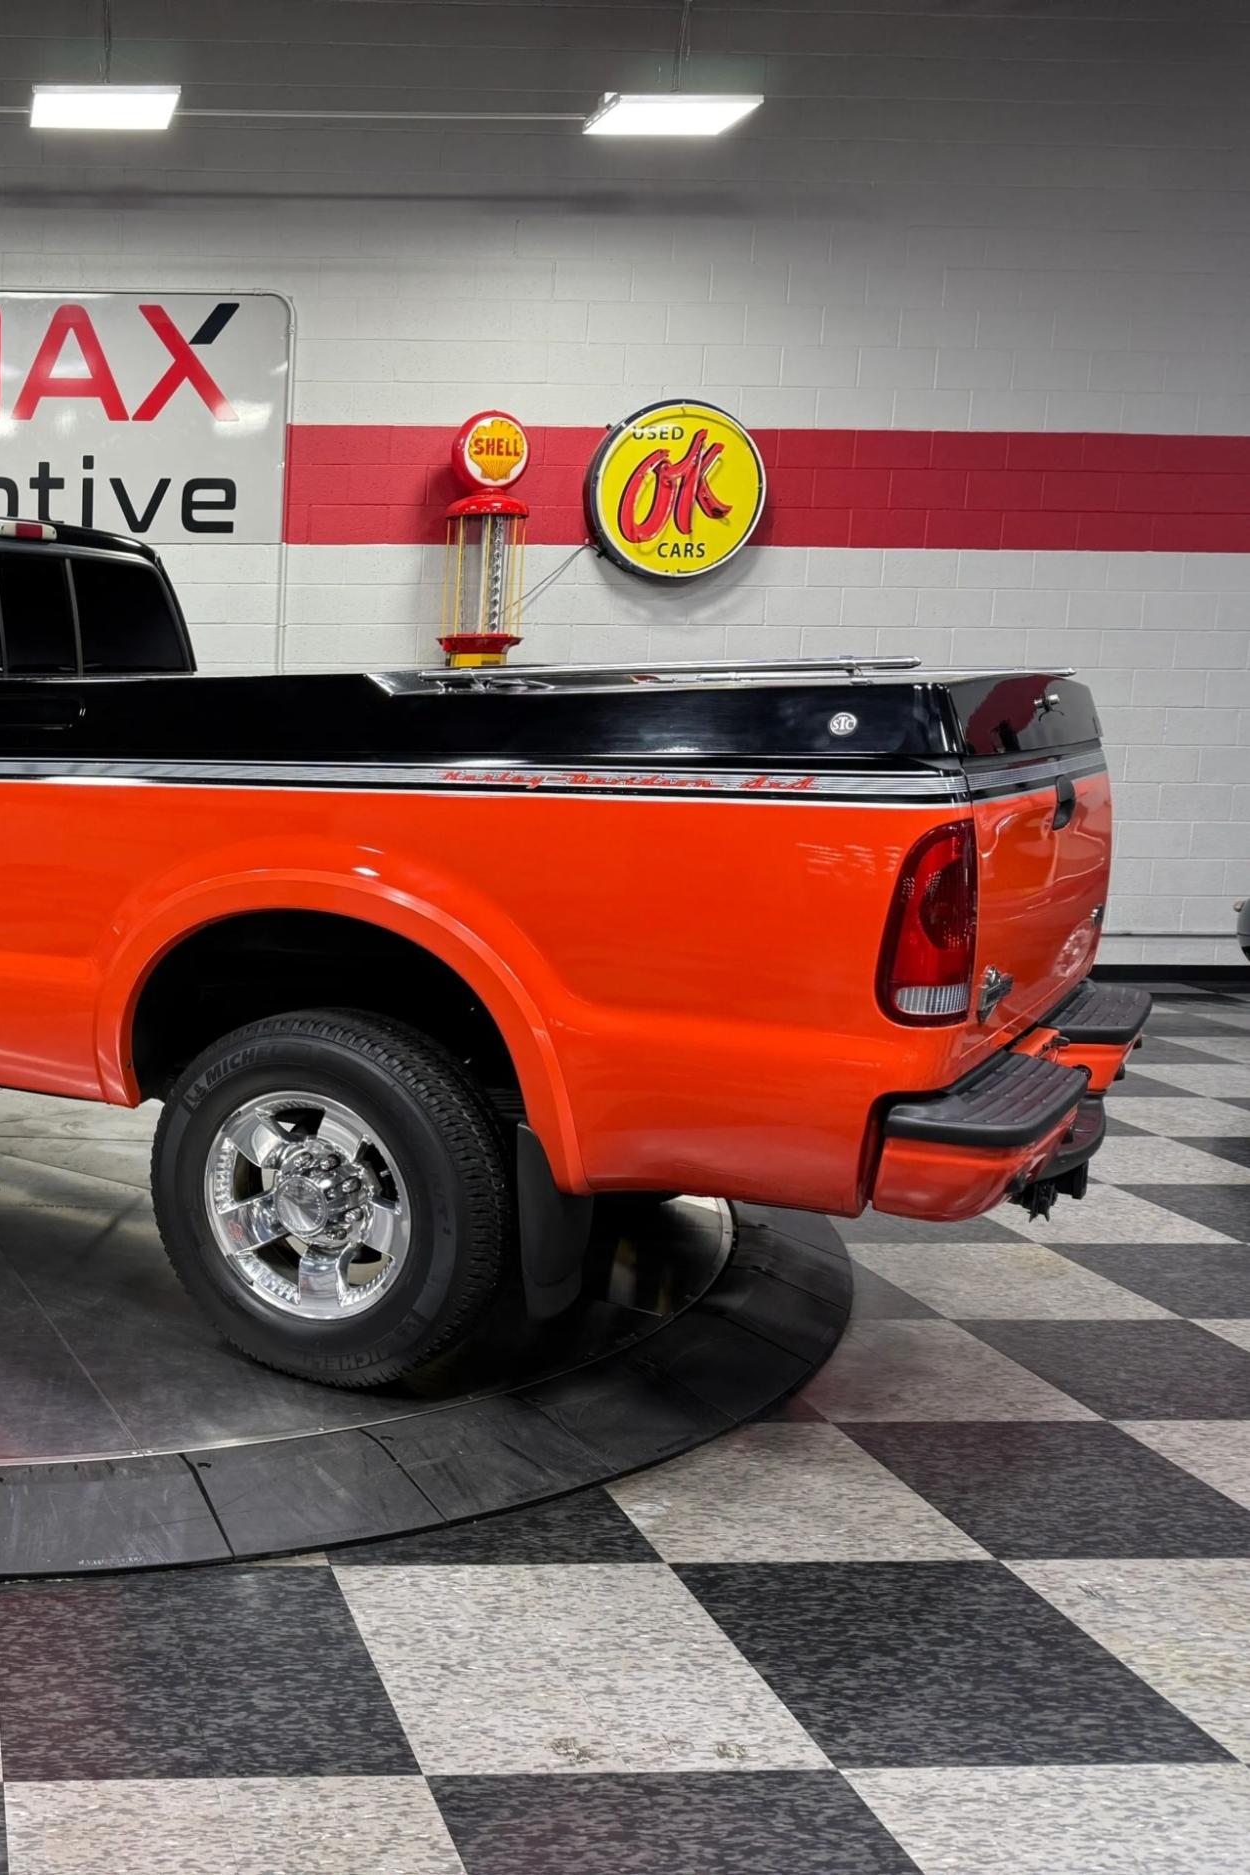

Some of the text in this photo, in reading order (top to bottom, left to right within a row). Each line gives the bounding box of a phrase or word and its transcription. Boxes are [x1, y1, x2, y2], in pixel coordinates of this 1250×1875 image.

[632, 425, 685, 441] USED
[473, 437, 522, 457] SHELL
[617, 428, 733, 544] OK
[656, 541, 706, 558] CARS
